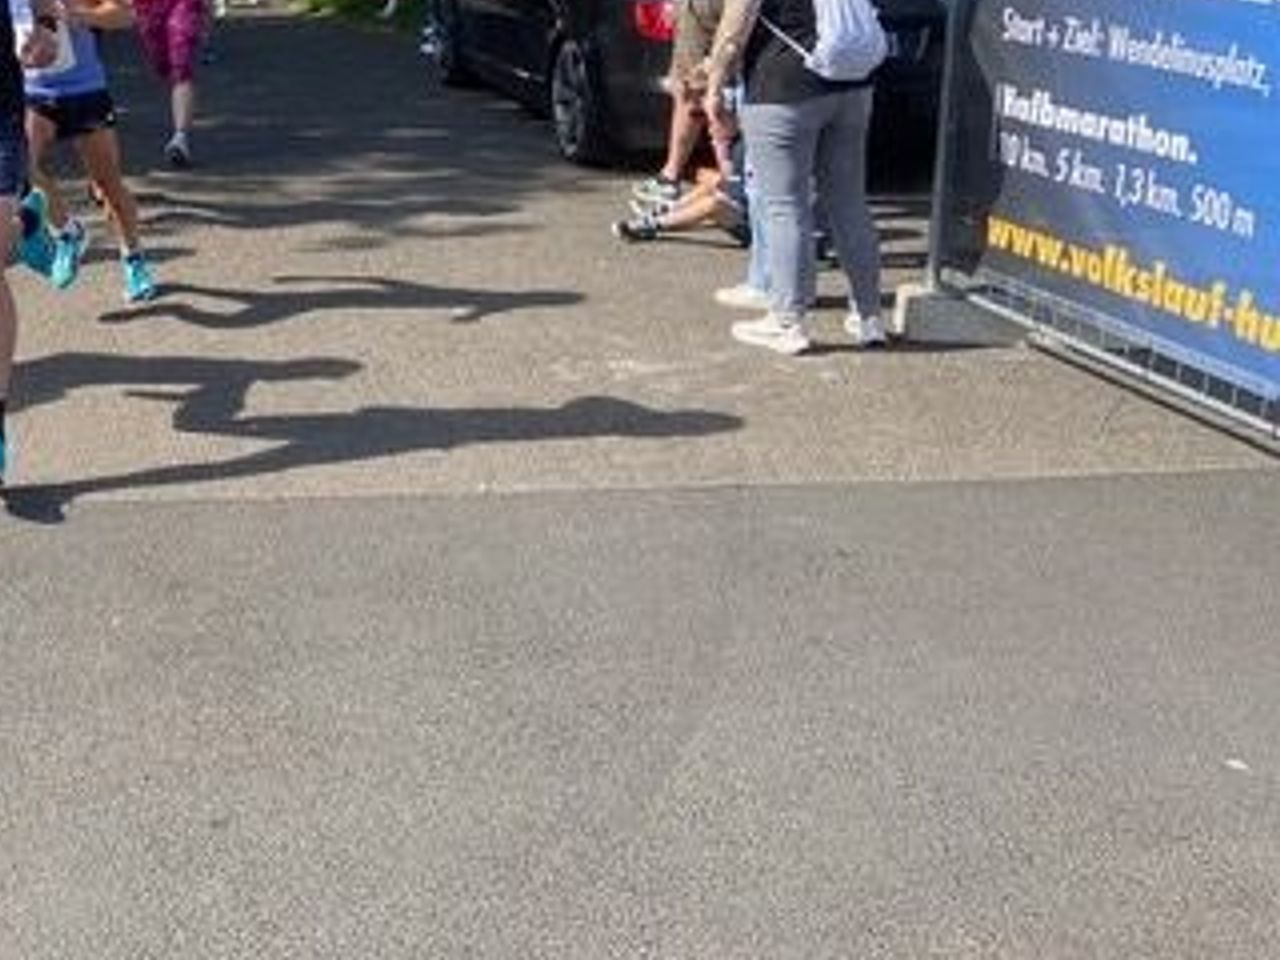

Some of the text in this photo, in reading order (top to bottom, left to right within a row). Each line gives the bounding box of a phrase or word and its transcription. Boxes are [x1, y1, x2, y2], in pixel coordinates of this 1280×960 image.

[1002, 5, 1045, 49] Start
[1063, 15, 1105, 59] Ziel:
[994, 83, 1198, 165] Halbmarathon.
[1053, 147, 1070, 183] 5
[1114, 163, 1145, 208] 1,3
[1190, 183, 1232, 231] 500
[1232, 204, 1256, 241] m
